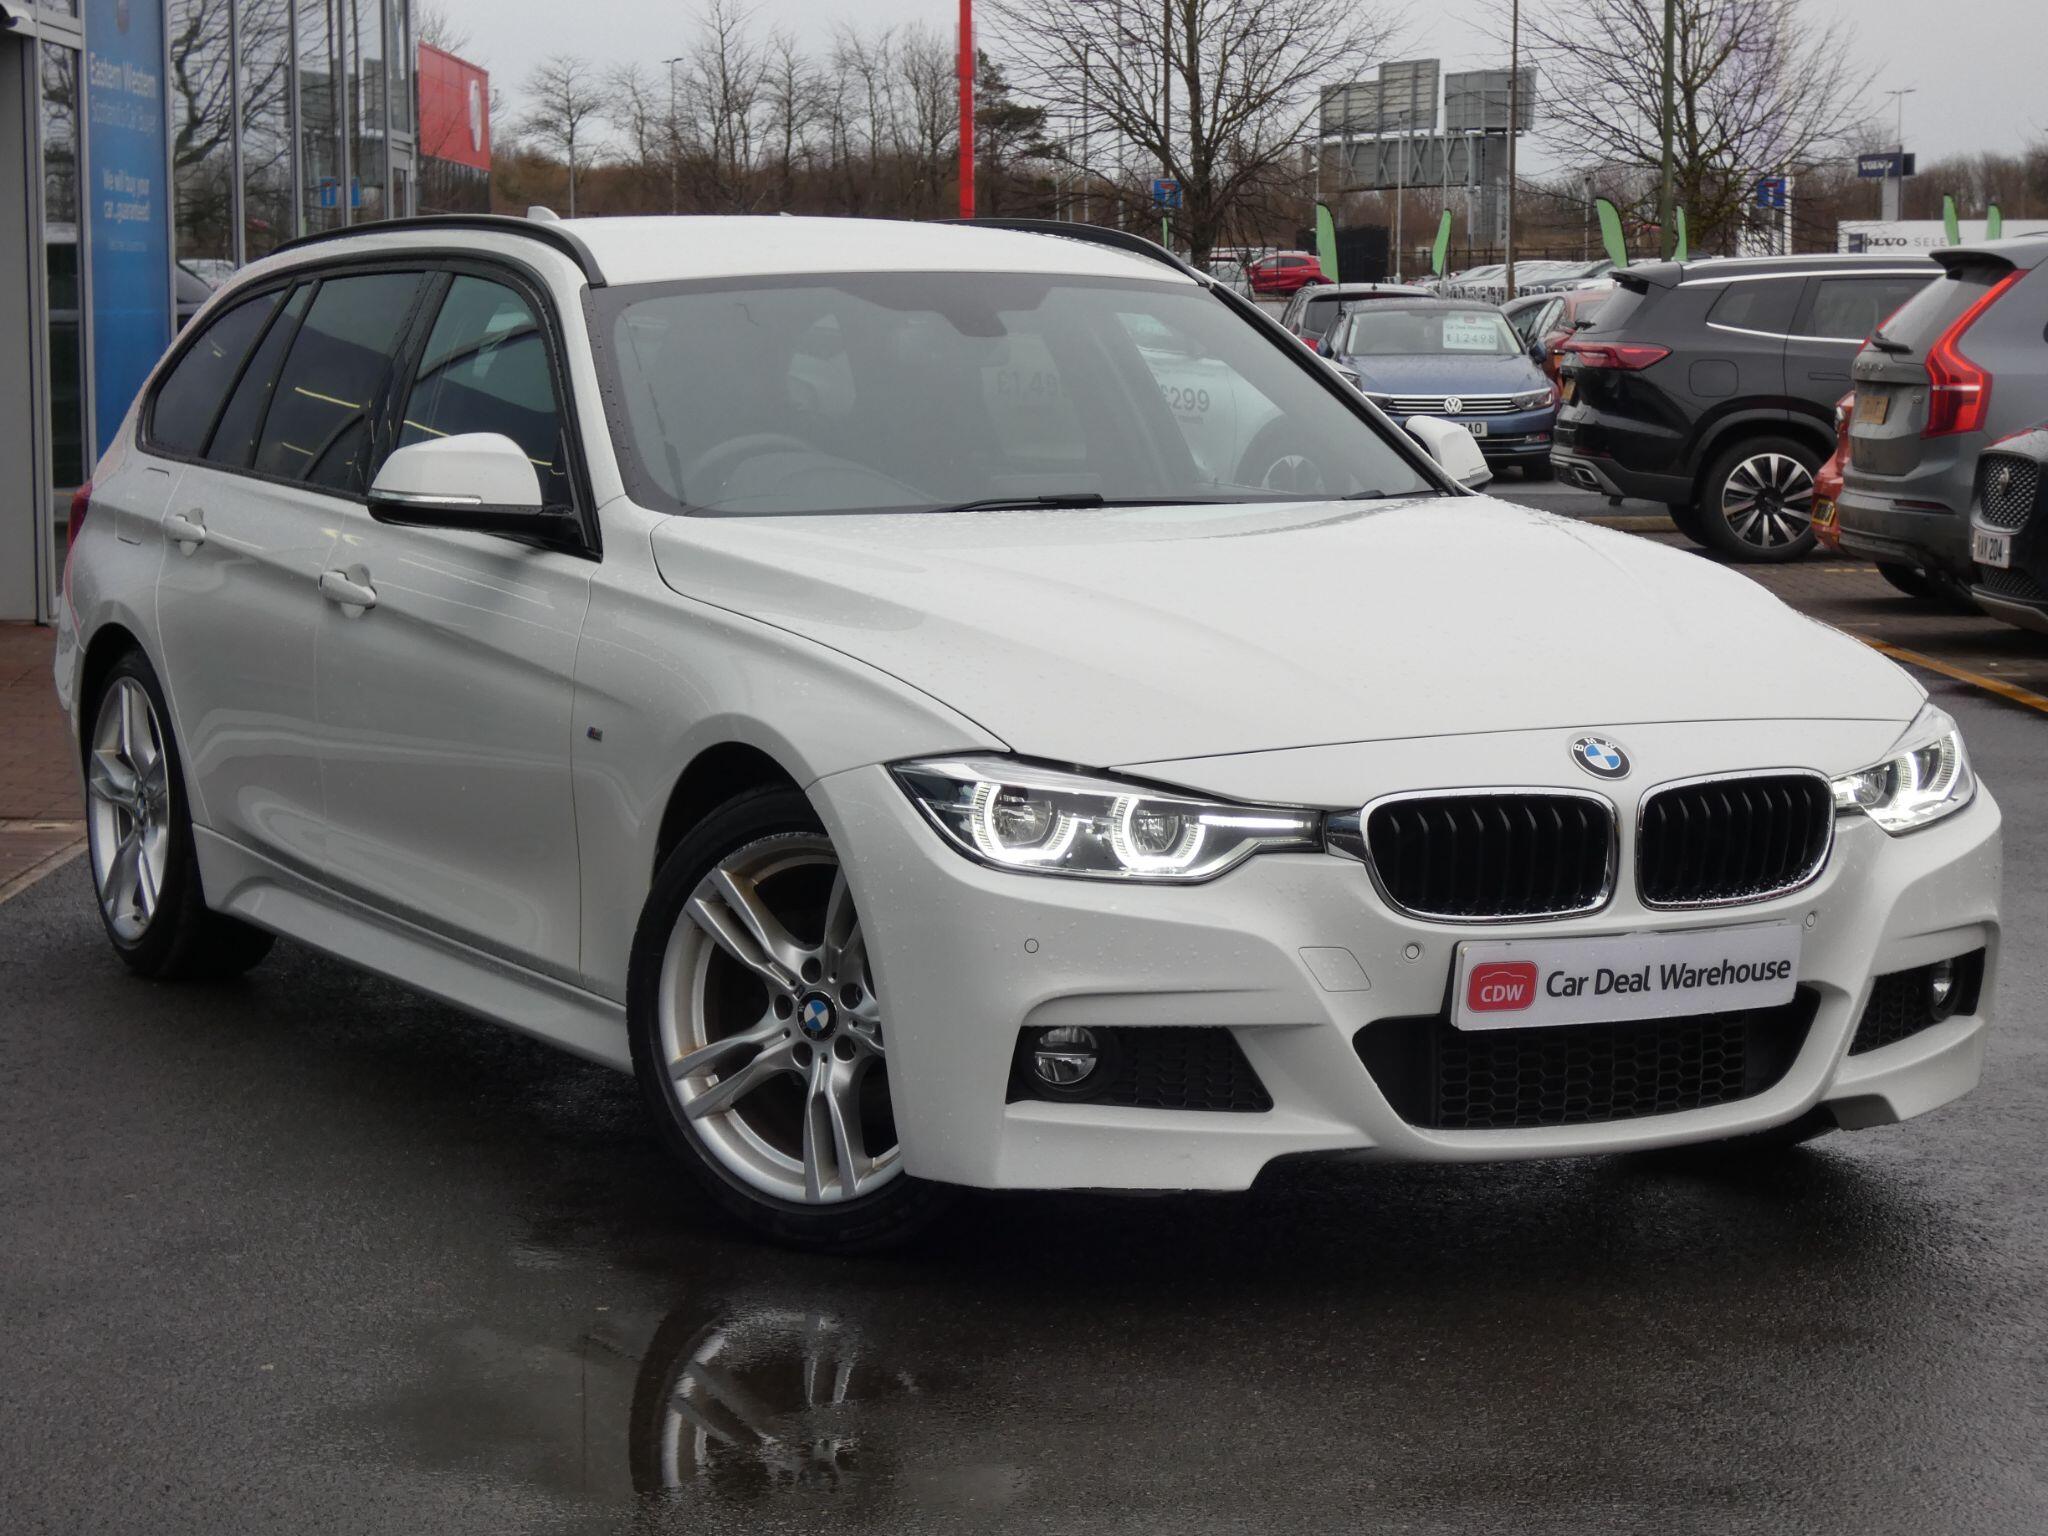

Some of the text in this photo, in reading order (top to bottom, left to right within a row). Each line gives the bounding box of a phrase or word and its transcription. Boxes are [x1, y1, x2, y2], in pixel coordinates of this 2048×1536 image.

[1864, 237, 1964, 247] OLVO SELE
[1546, 959, 1792, 998] Car Deal Warehouse
[1480, 985, 1525, 1003] CDW
